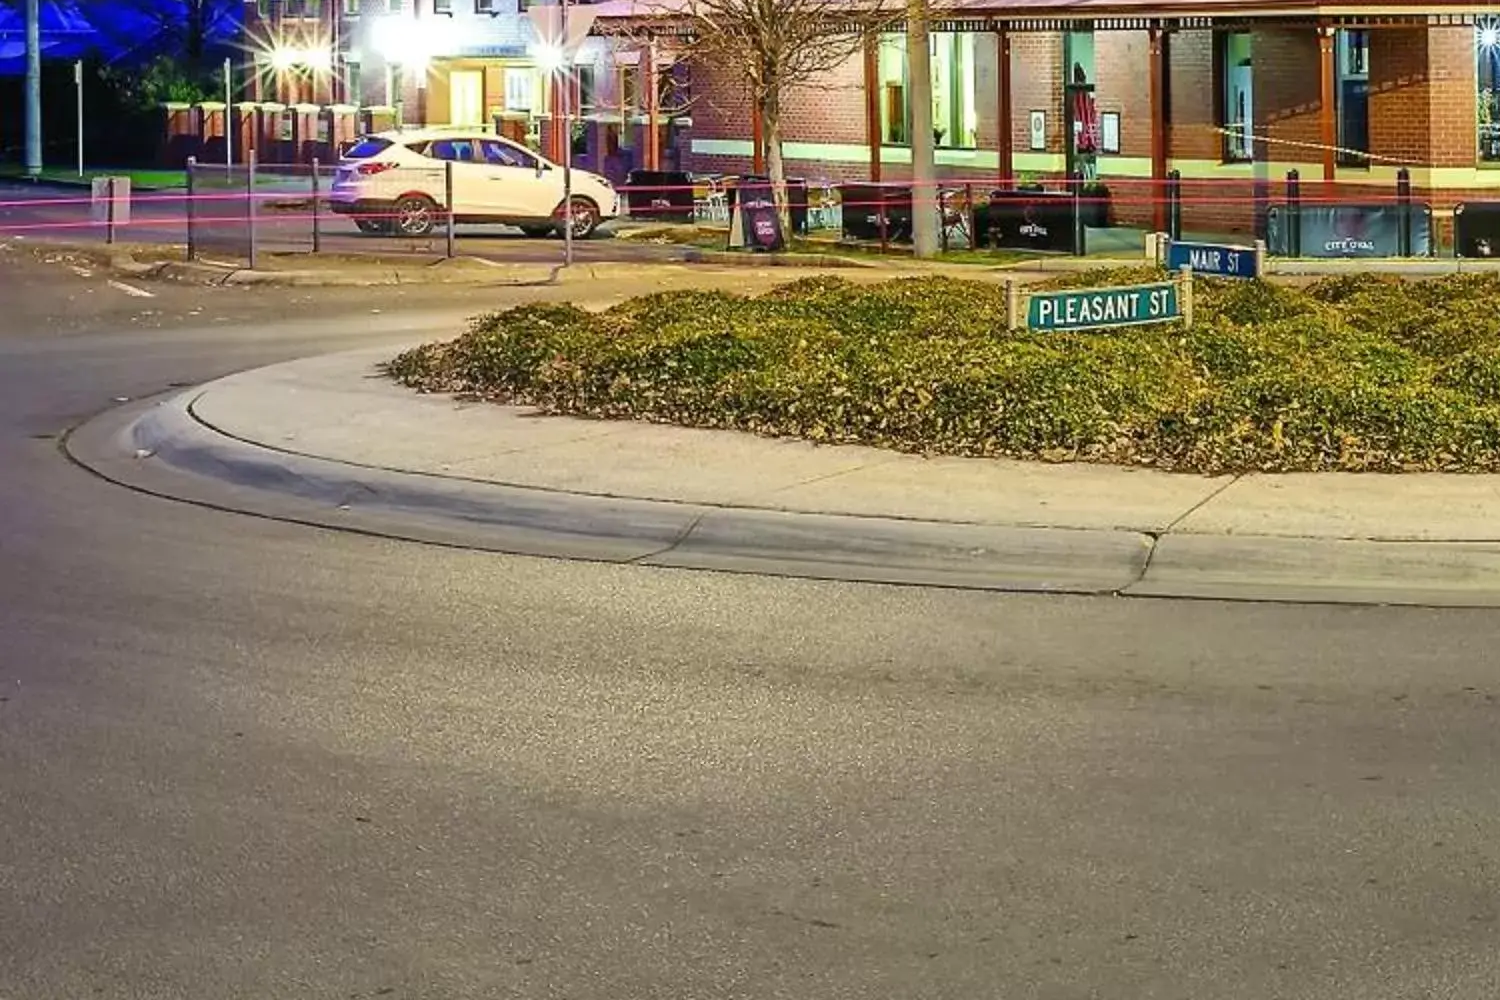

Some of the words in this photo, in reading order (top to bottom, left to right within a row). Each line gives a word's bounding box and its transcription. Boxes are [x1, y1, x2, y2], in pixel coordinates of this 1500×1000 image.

[1189, 250, 1221, 271] MAIR
[1227, 254, 1240, 273] ST
[1038, 292, 1140, 325] PLEASANT
[1149, 289, 1169, 316] ST
